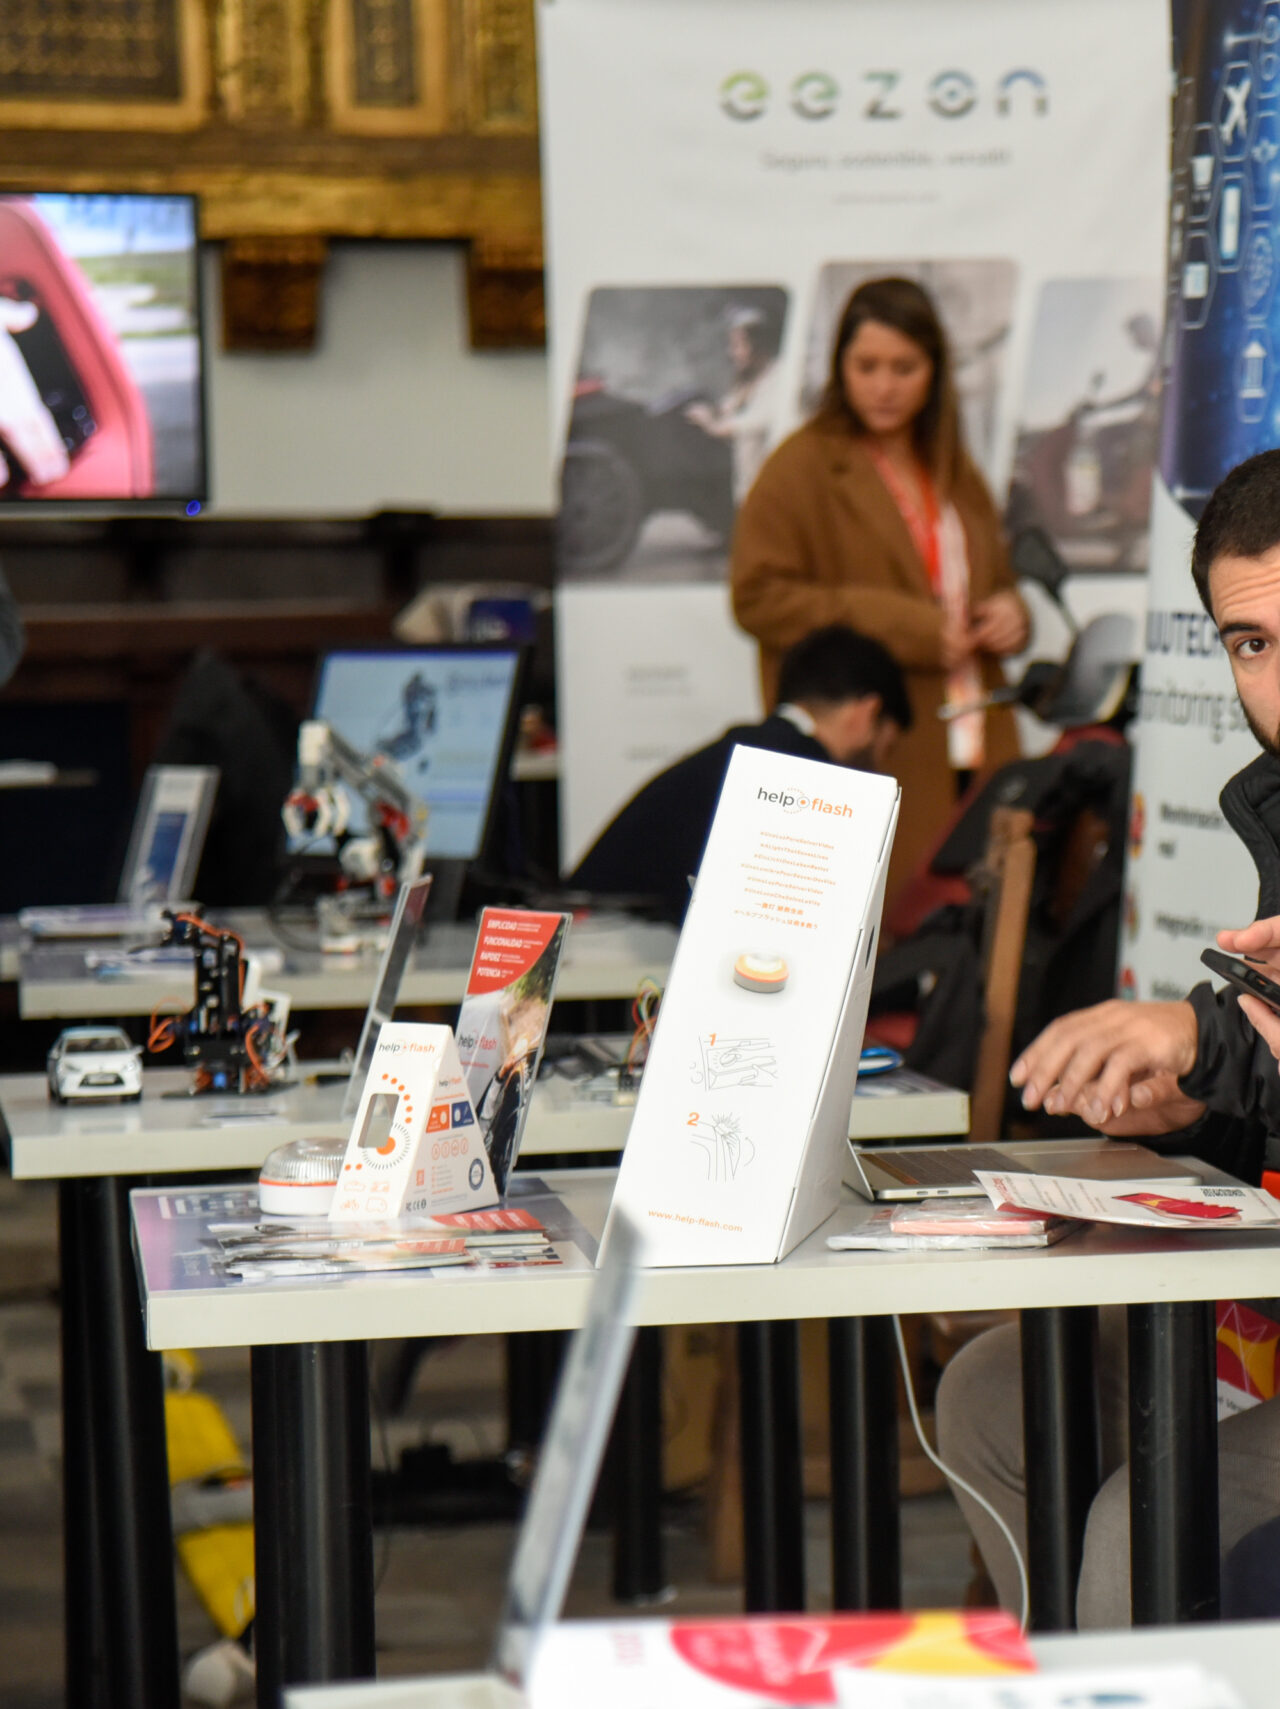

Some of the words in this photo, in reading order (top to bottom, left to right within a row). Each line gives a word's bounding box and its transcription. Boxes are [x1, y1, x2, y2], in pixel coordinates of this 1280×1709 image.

[719, 69, 1049, 122] eezon
[757, 786, 795, 808] help
[811, 797, 853, 818] flash
[709, 1033, 717, 1046] 1
[379, 1042, 401, 1053] help
[409, 1043, 435, 1053] flash
[687, 1112, 700, 1126] 2
